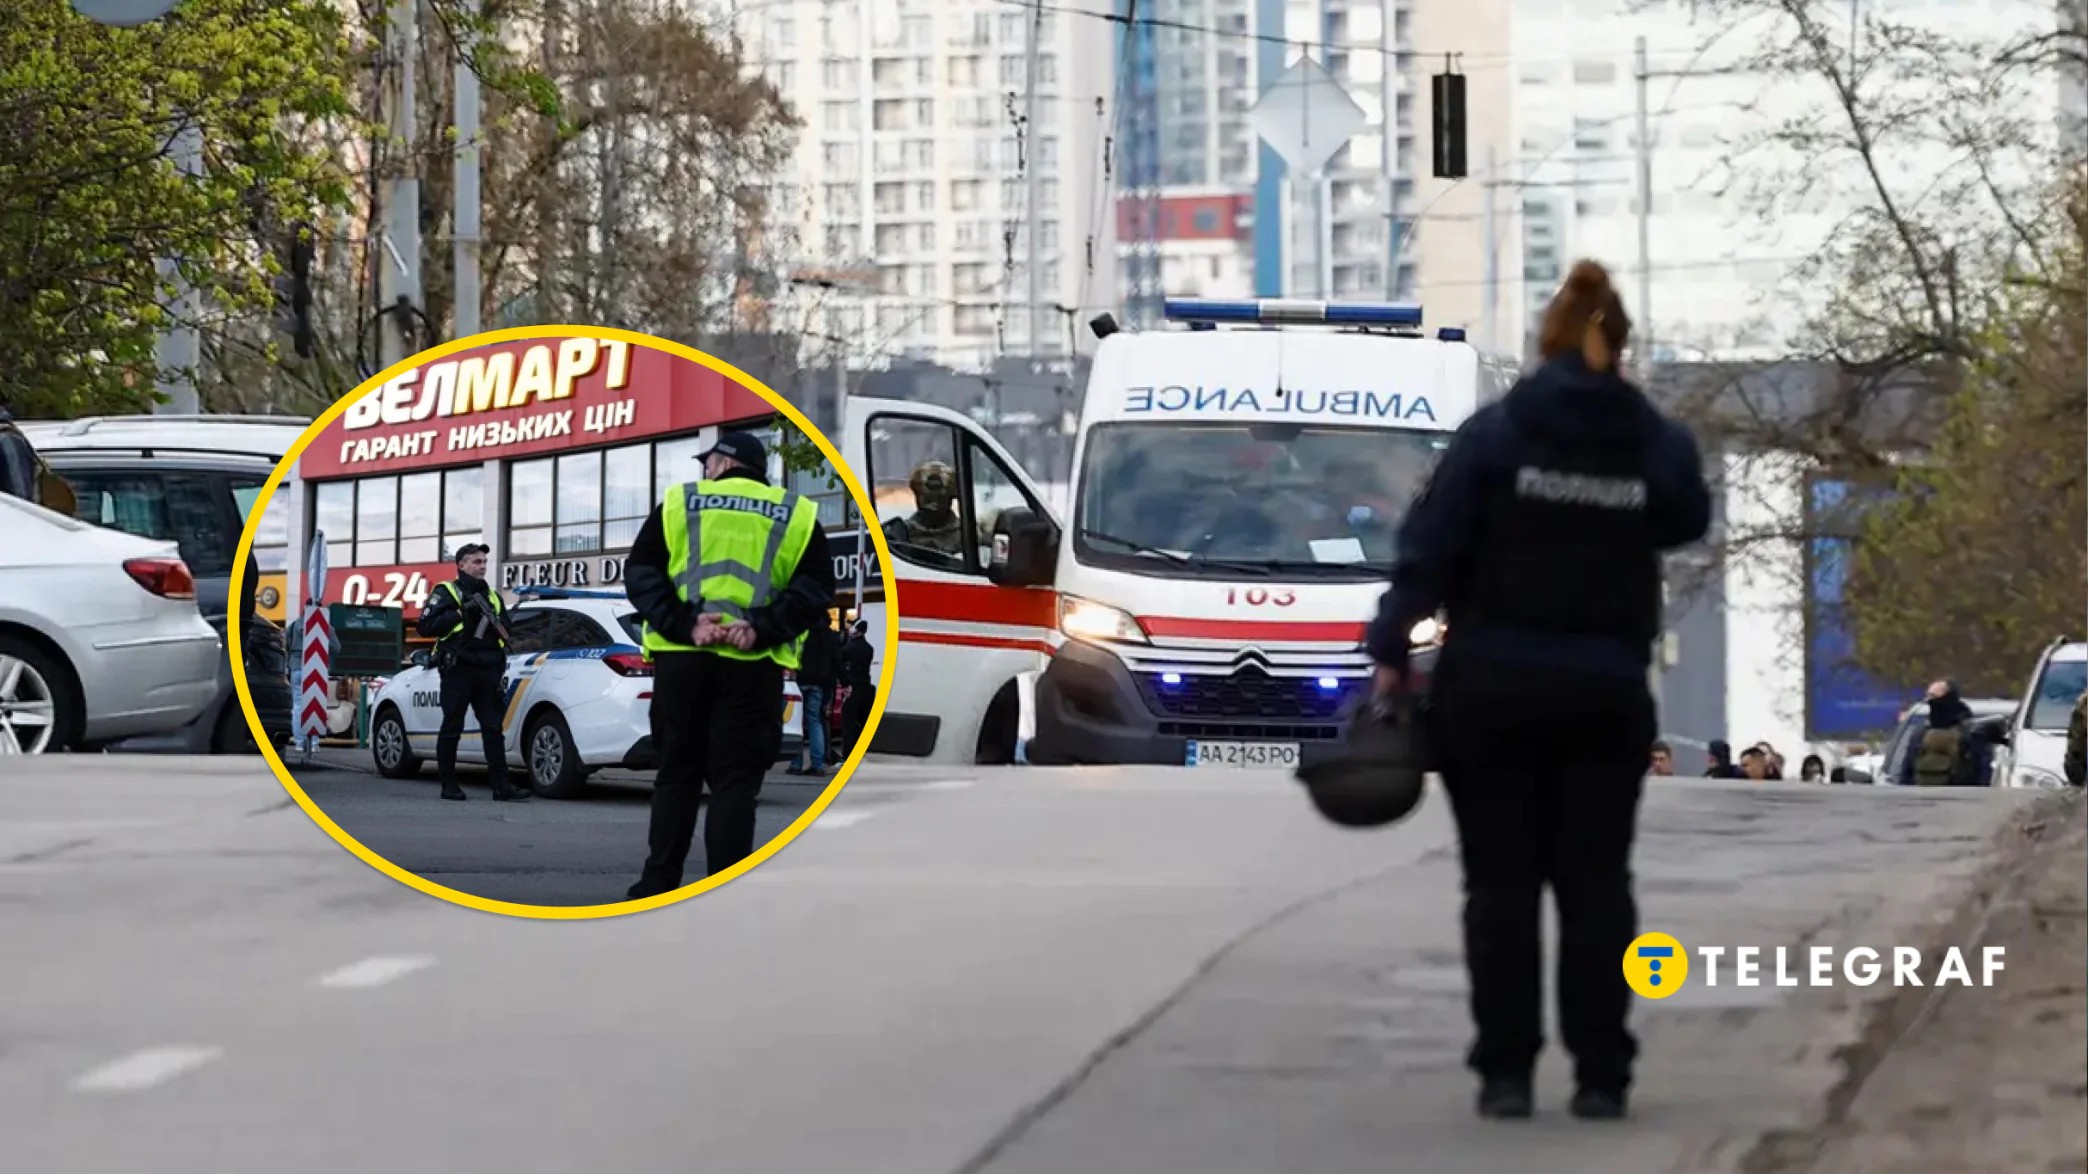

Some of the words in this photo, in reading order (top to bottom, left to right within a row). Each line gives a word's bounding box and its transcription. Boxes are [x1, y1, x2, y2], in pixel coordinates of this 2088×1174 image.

[340, 430, 438, 464] ГАРАНТ
[448, 411, 571, 451] НИЗЬКИХ
[584, 399, 636, 433] ЦІН
[688, 494, 790, 522] ПОЛІЦІЯ
[502, 561, 588, 589] FLEUR
[831, 553, 876, 580] ORY
[342, 571, 428, 609] 0-24
[1226, 586, 1296, 607] 103
[1200, 745, 1222, 762] AA
